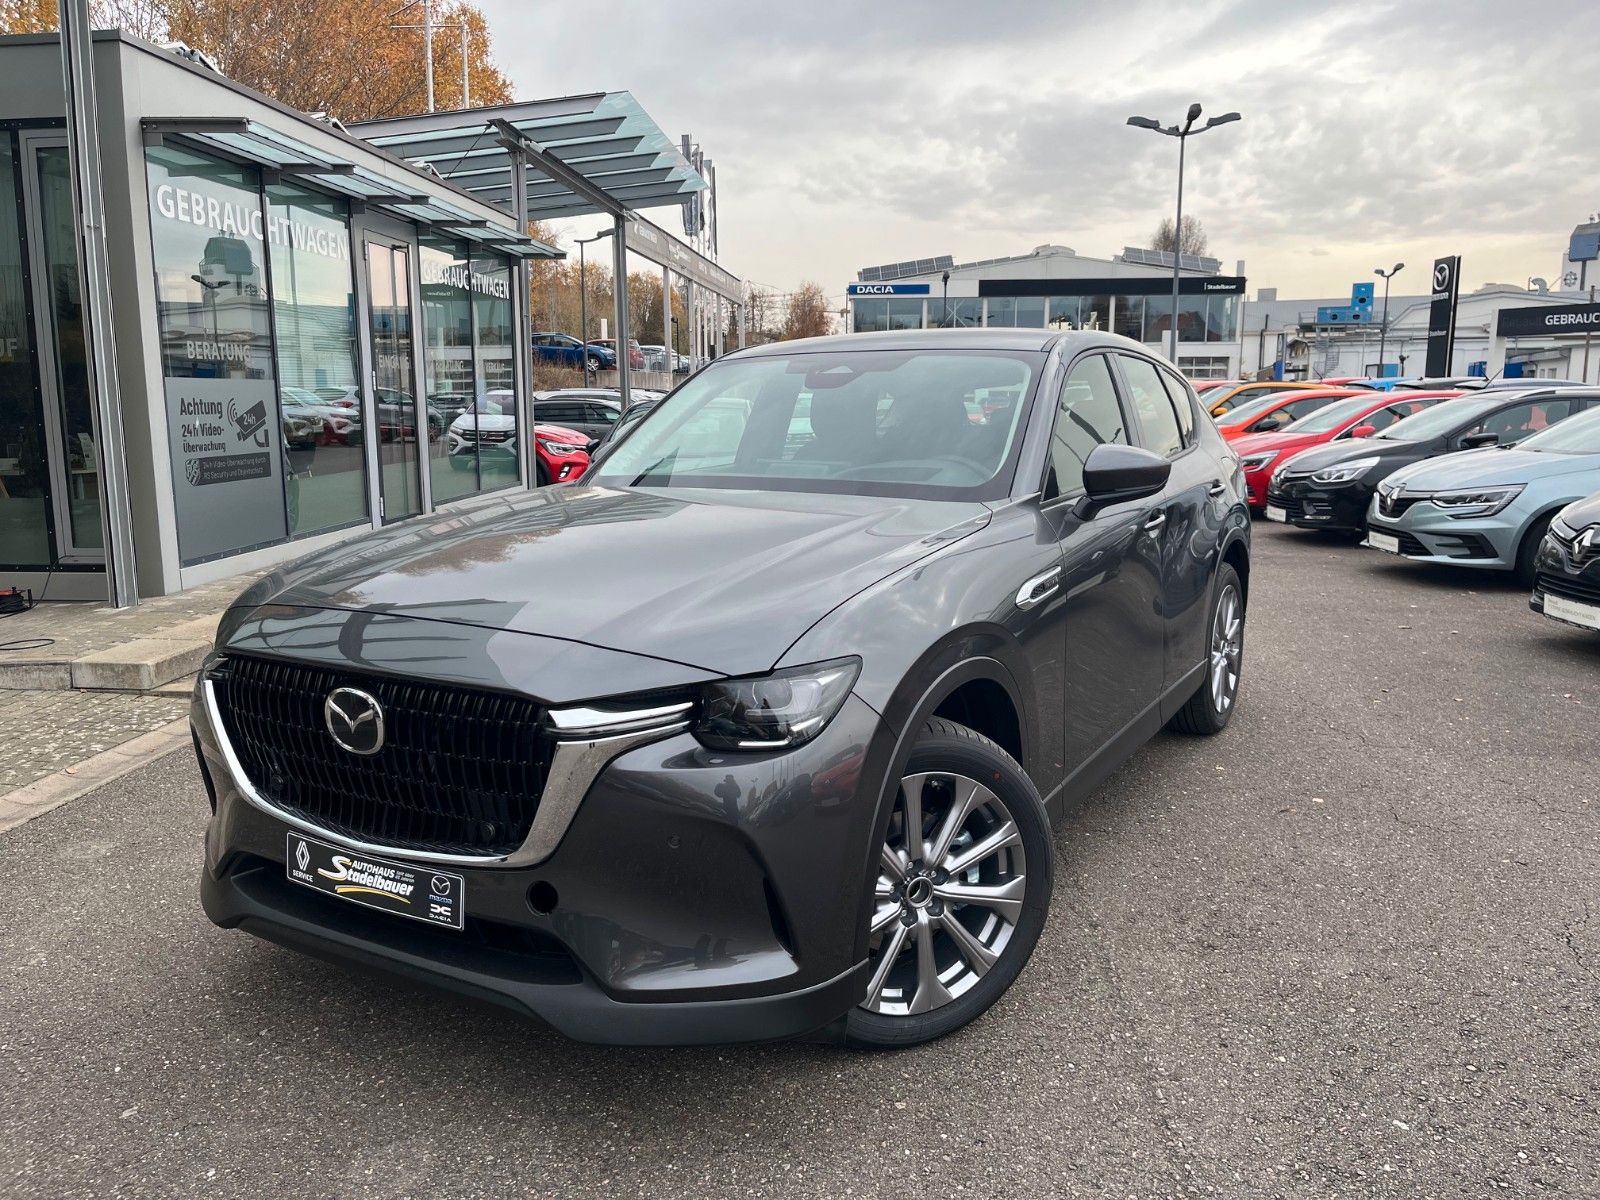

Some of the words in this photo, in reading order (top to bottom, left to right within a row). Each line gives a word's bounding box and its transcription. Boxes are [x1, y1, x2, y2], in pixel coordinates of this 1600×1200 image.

[156, 184, 348, 261] GEBRAUCHTWAGEN
[423, 262, 509, 299] GEBRAUCHTWAGEN
[856, 285, 894, 294] DACIA
[1545, 312, 1600, 326] GEBRAUC
[186, 340, 251, 362] BERATUNG
[180, 397, 223, 419] Achtung
[243, 413, 256, 425] 24h
[200, 423, 225, 437] Video-
[183, 439, 226, 453] Überwachung
[292, 869, 314, 883] SERVICE
[317, 855, 414, 896] Stadelbauer
[351, 860, 395, 879] AUTOHAUS
[428, 913, 452, 922] DACIA
